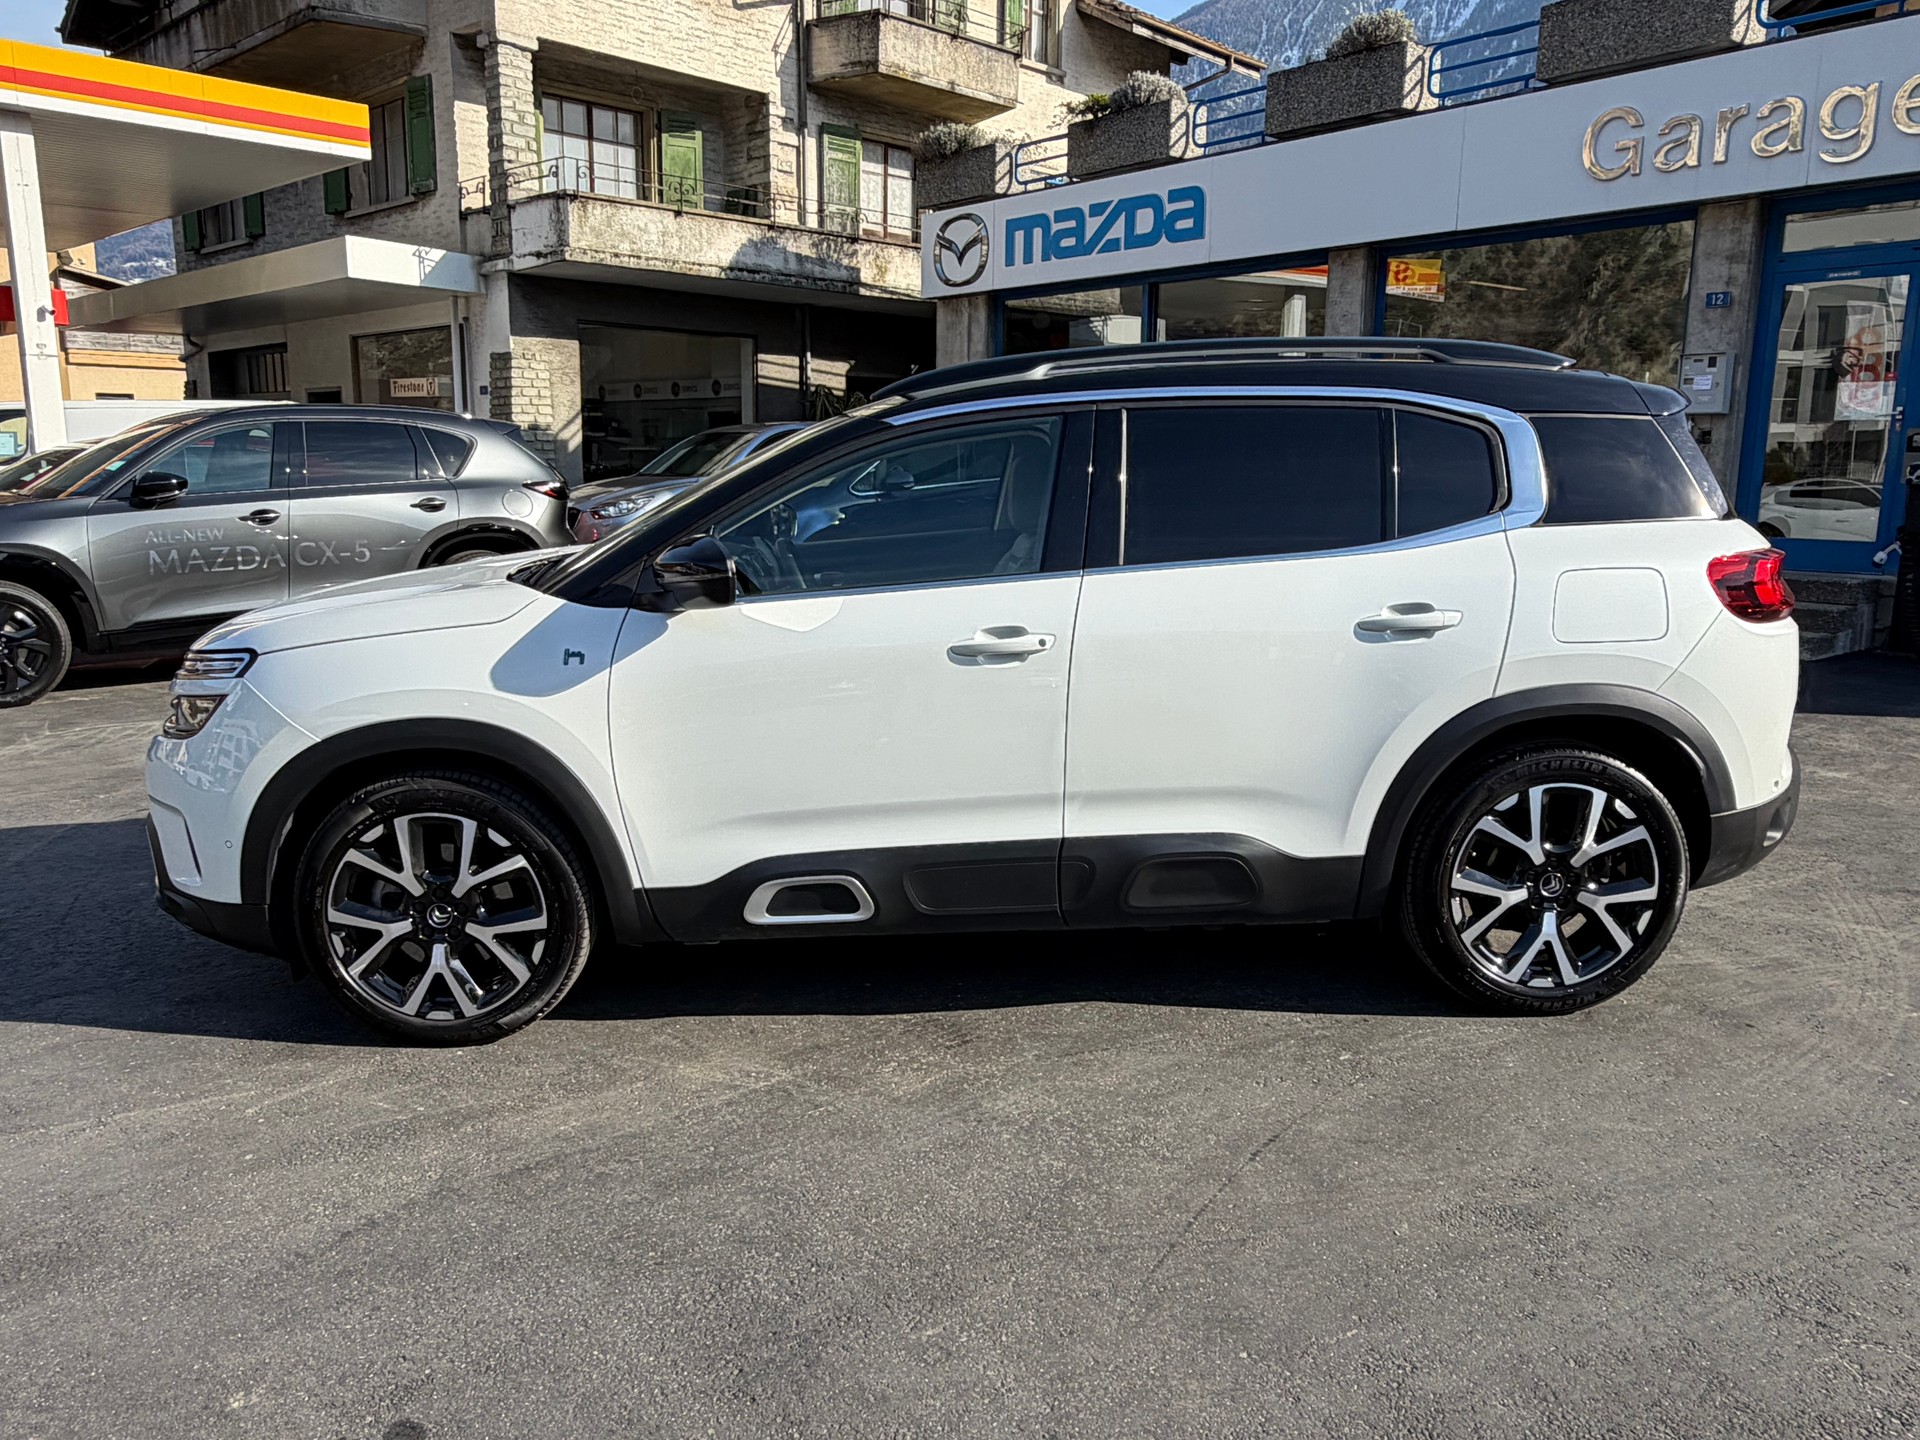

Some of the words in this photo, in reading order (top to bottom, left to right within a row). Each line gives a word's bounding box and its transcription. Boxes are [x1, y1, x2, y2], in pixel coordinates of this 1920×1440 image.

[1711, 294, 1724, 305] 12
[393, 381, 424, 395] Firestone
[145, 528, 225, 544] ALL-NEW
[150, 543, 287, 575] MAZDA
[296, 539, 371, 567] CX-5
